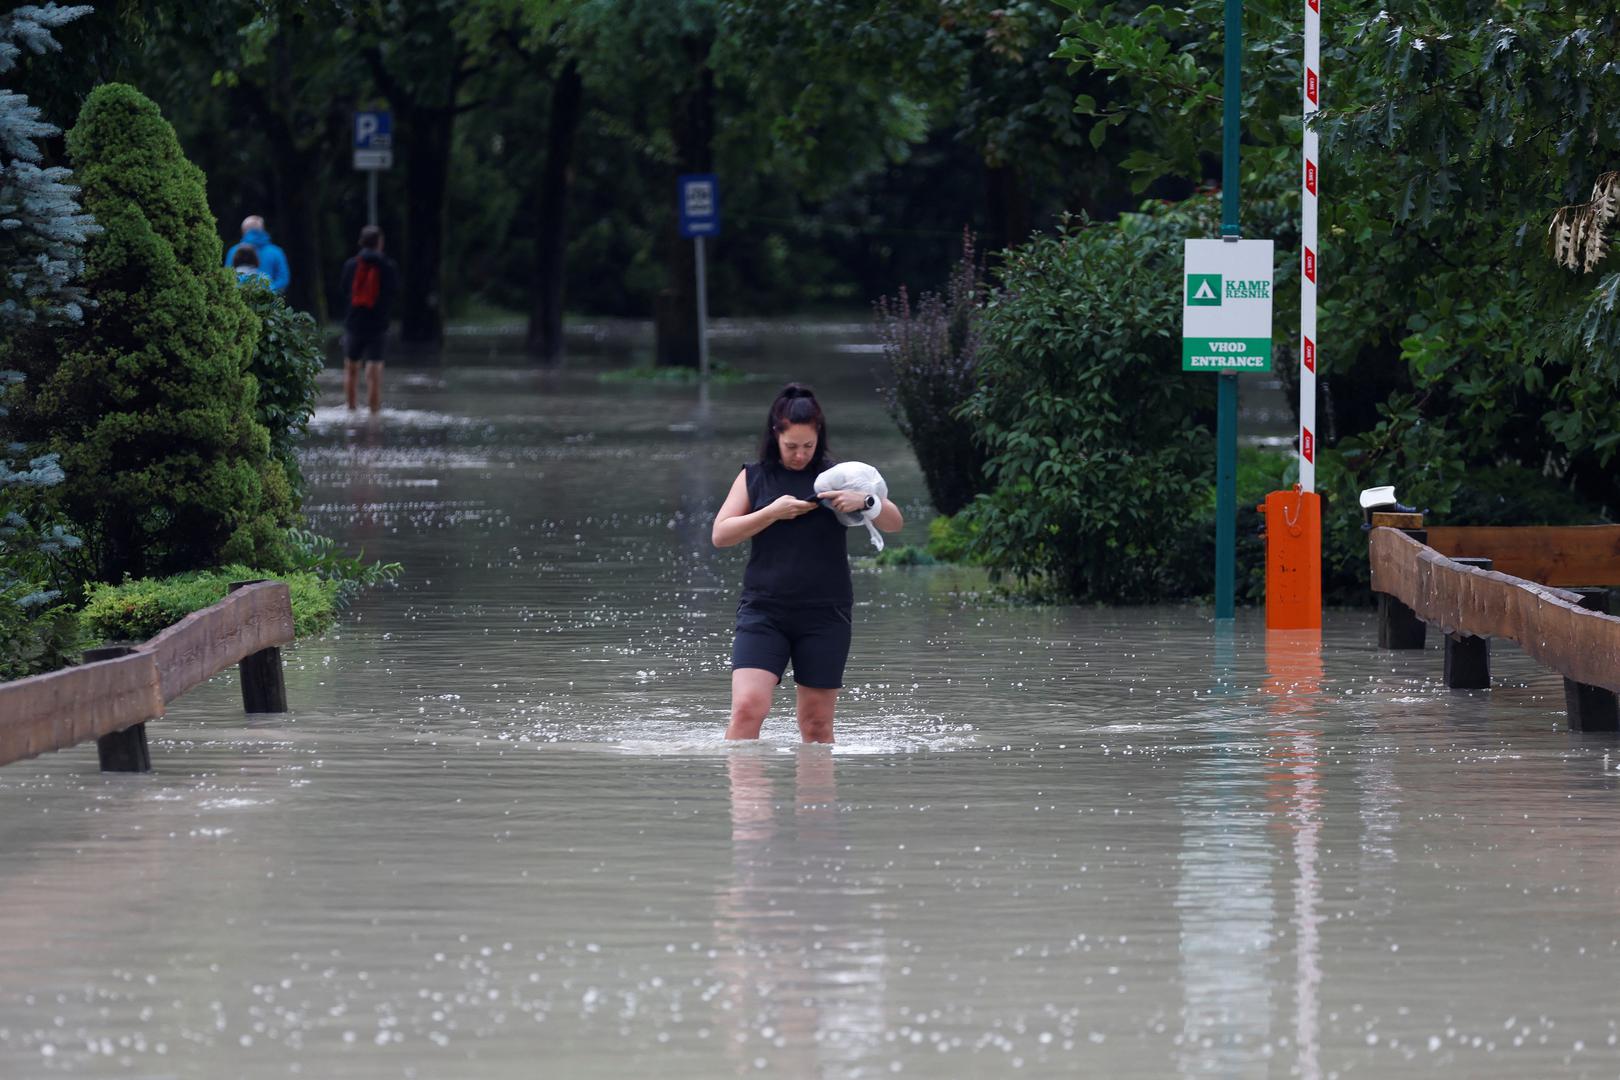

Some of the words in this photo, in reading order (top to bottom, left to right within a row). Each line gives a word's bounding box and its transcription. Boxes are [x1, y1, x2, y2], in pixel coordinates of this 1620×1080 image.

[356, 114, 378, 143] P
[1225, 280, 1270, 291] KAMP
[1225, 290, 1270, 299] RESNIK
[1208, 341, 1247, 353] VHOD
[1190, 355, 1264, 367] ENTRANCE
